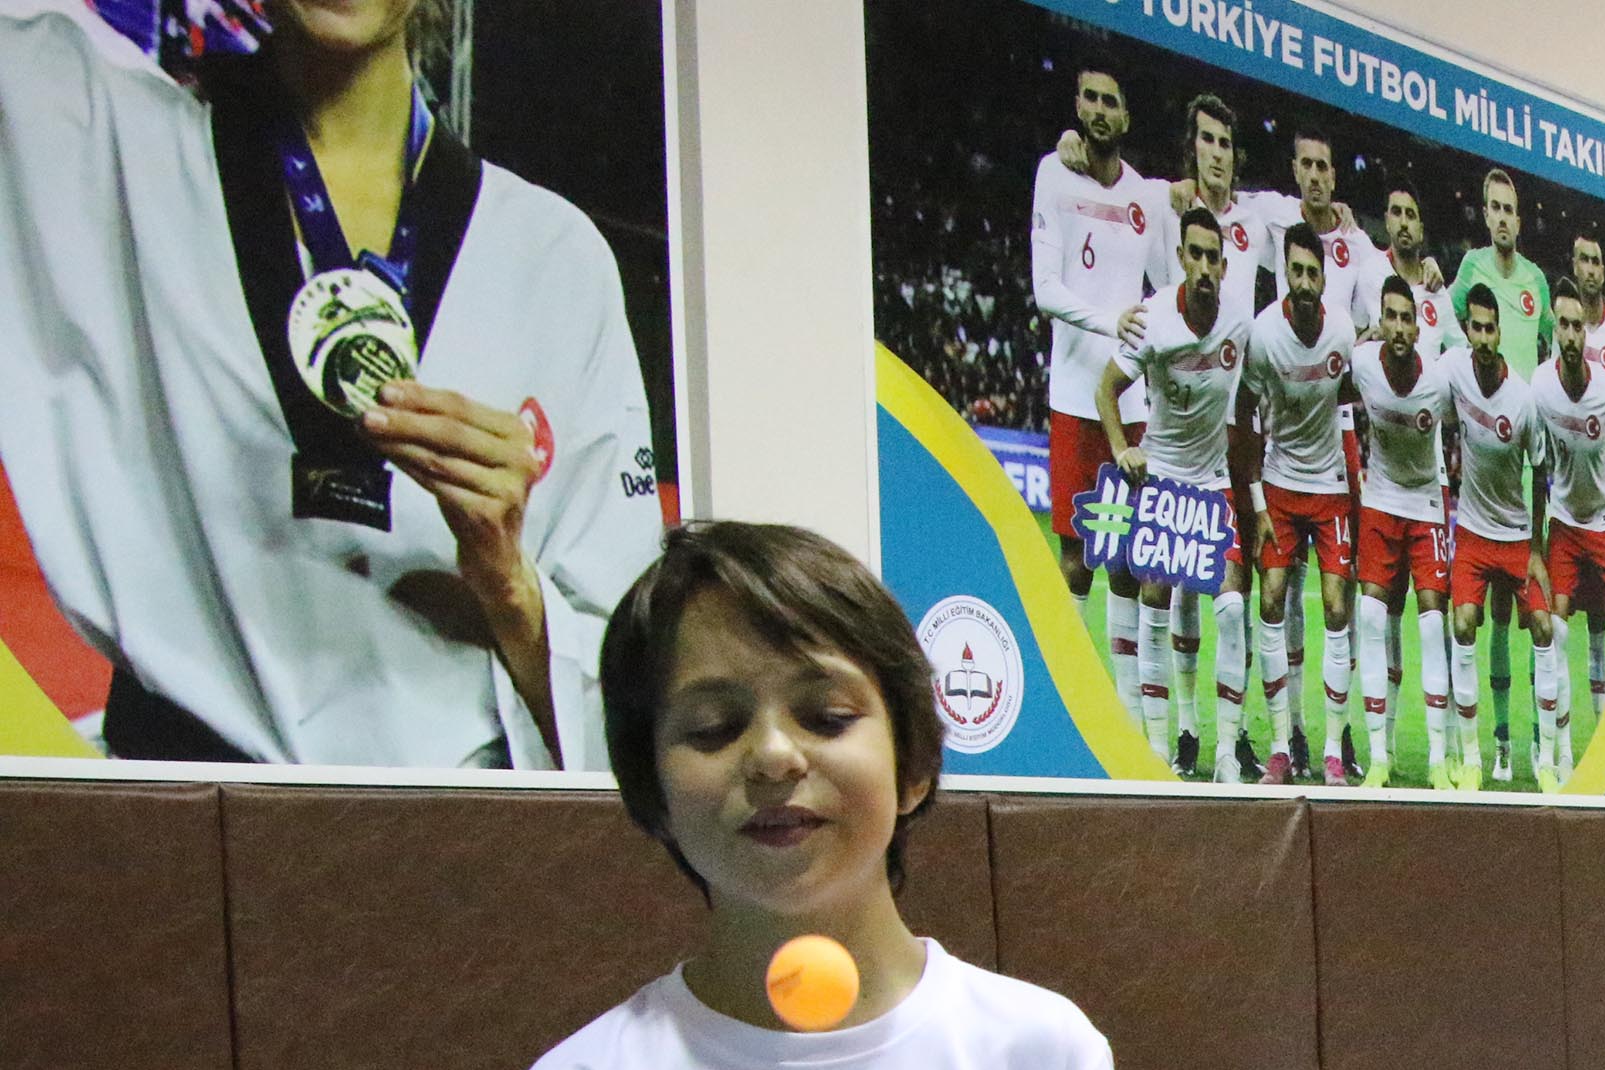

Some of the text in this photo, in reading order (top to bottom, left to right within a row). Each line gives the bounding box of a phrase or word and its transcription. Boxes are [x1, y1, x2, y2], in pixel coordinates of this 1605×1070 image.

[1313, 35, 1447, 120] FUTBOL
[1455, 88, 1532, 150] MİLLİ
[1138, 486, 1226, 542] EQUAL
[1132, 526, 1216, 580] GAME
[950, 605, 975, 617] EĞİTİM
